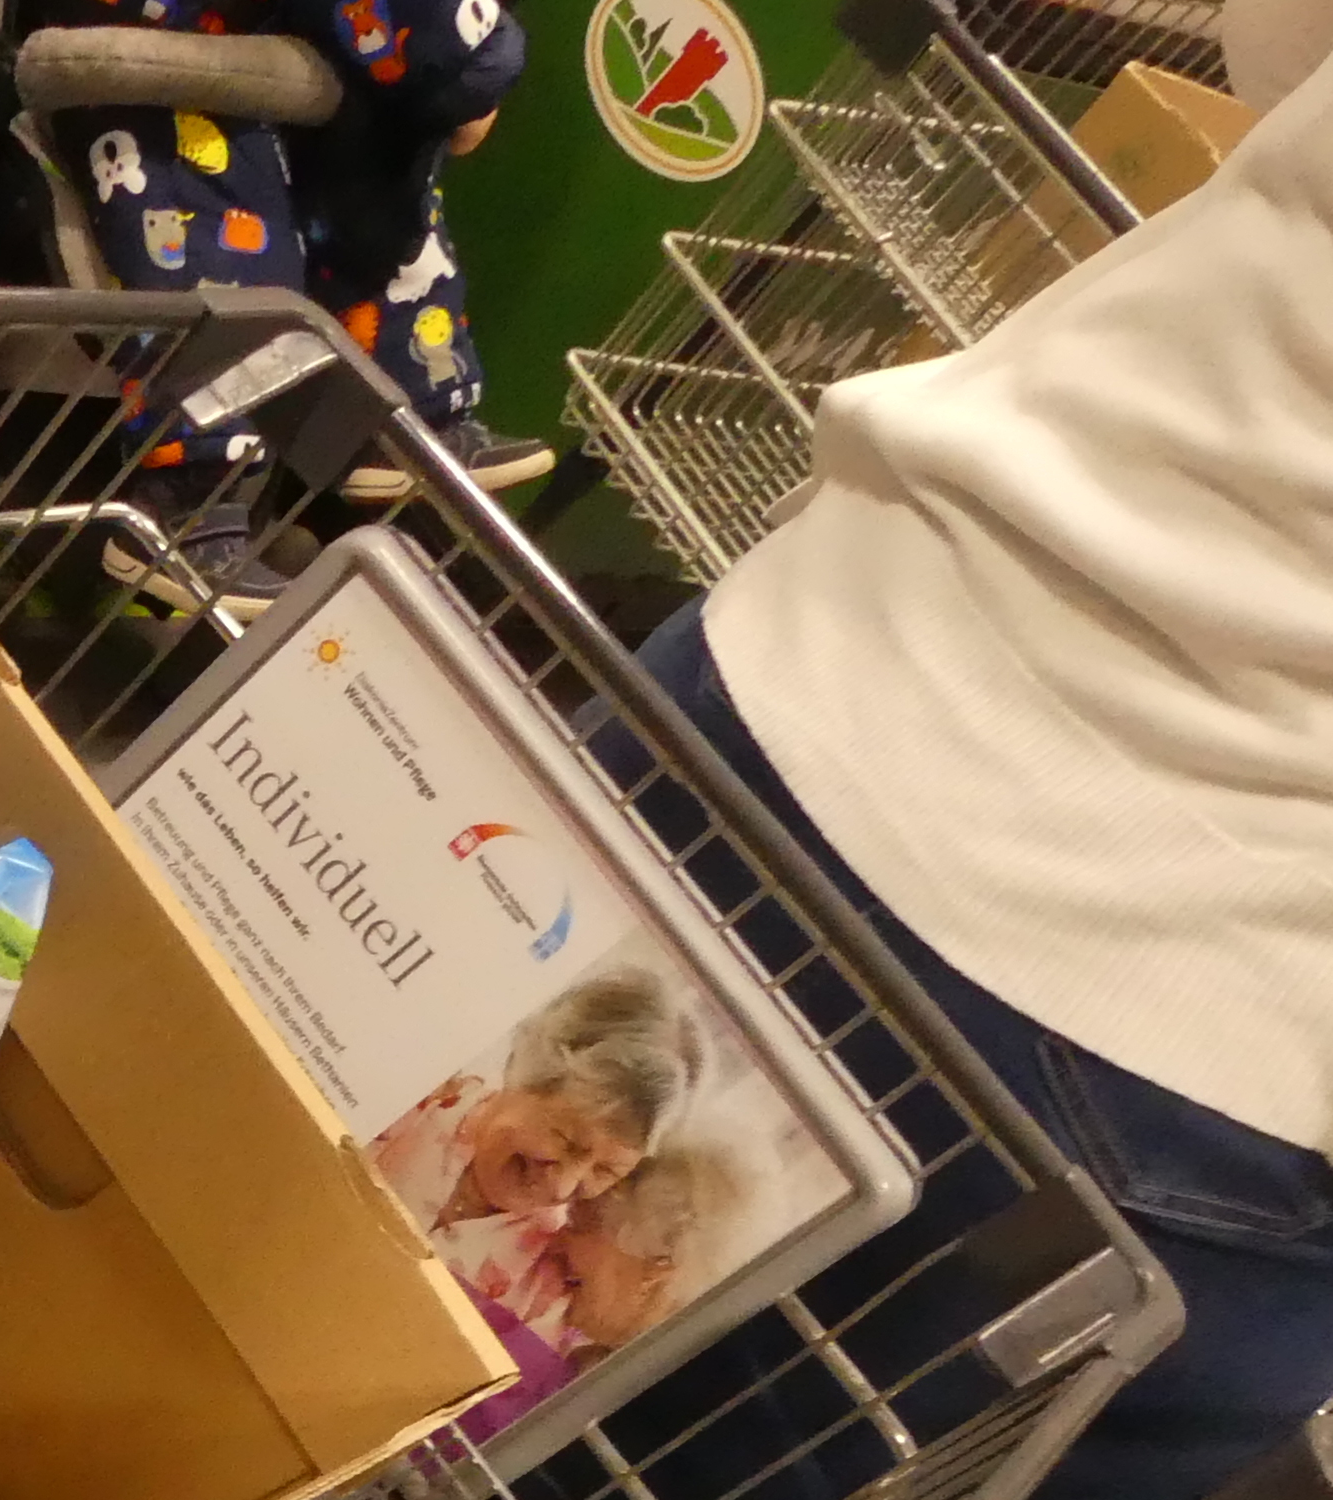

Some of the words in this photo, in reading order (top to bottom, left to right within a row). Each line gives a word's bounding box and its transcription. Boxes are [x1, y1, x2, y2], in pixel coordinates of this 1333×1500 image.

[344, 683, 384, 737] Wohnen
[382, 735, 408, 762] und
[402, 758, 436, 801] Pflege
[177, 768, 197, 790] wie
[195, 790, 216, 814] das
[213, 814, 250, 859] Leben,
[246, 859, 261, 875] so
[259, 874, 294, 916] helfen
[206, 709, 435, 992] Individuell
[192, 858, 212, 881] und
[236, 919, 261, 948] ganz
[260, 947, 285, 976] nach
